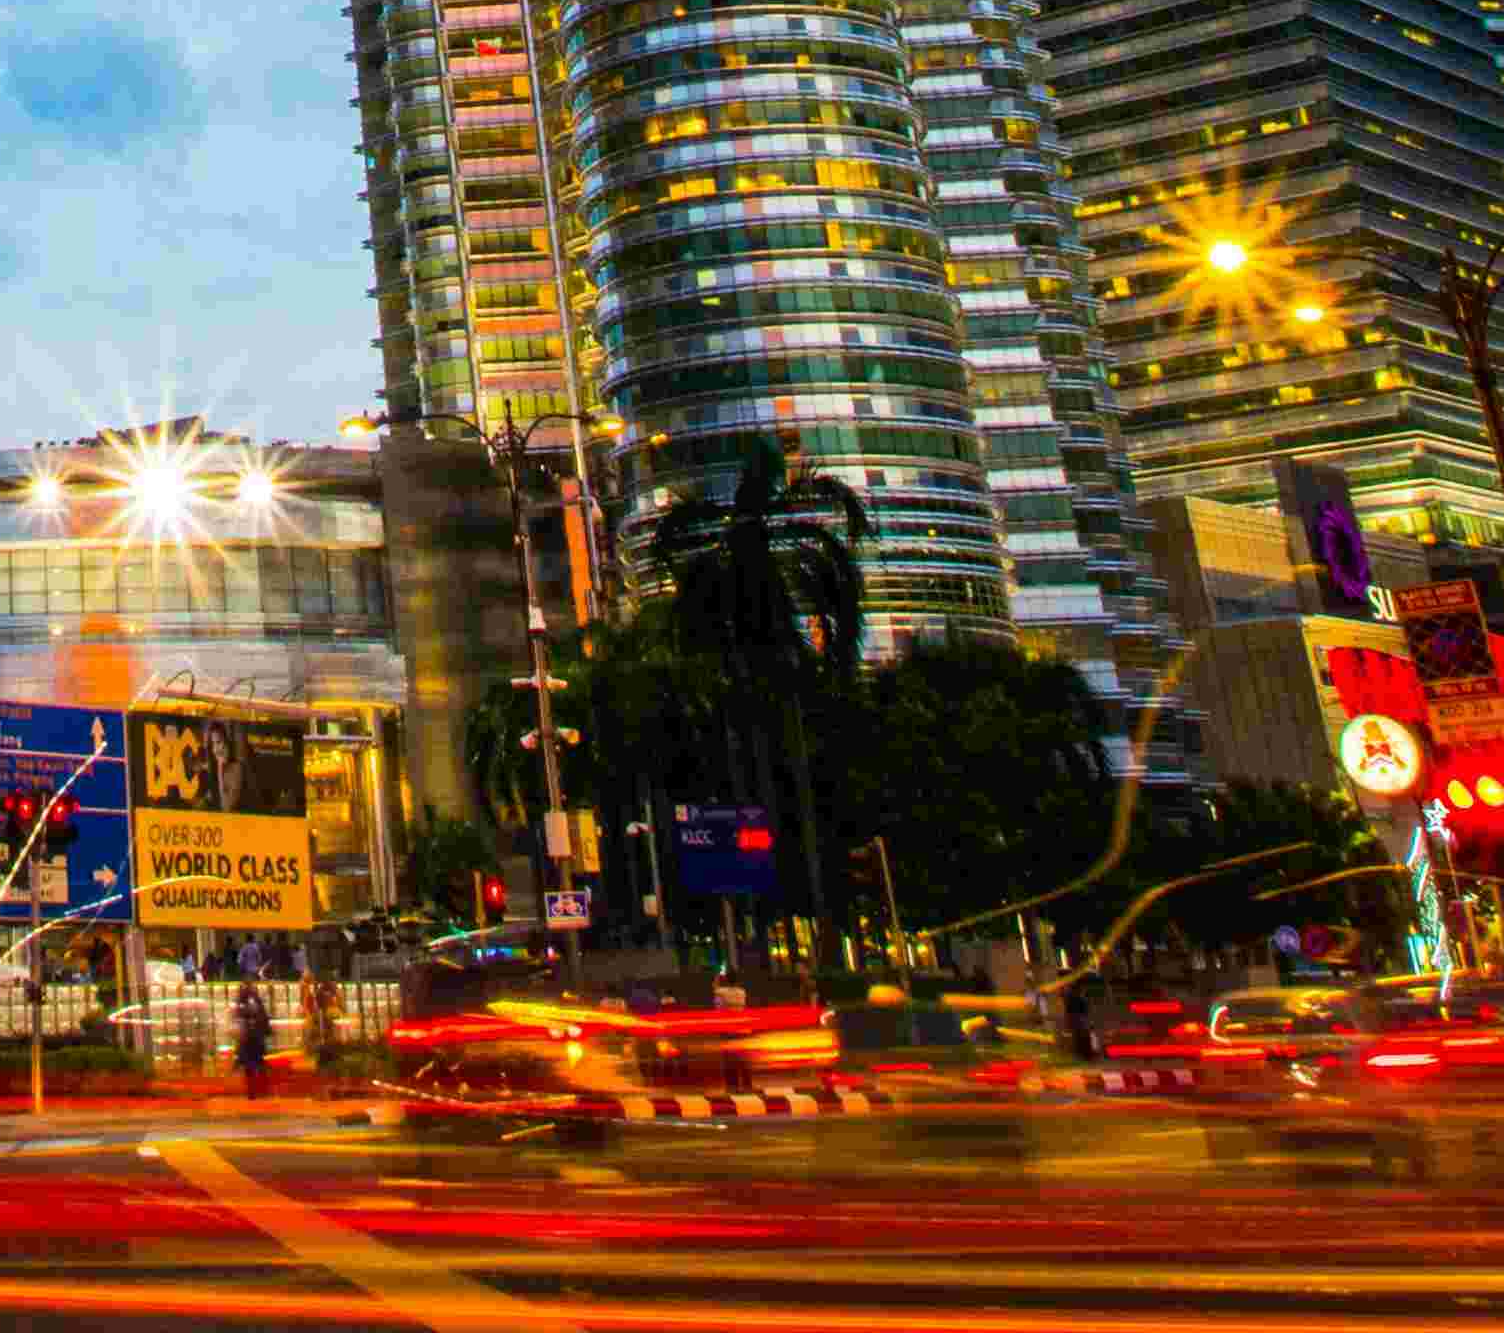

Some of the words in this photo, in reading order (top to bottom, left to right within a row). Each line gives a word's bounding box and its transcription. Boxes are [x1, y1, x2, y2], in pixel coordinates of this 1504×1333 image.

[148, 824, 189, 846] OVER
[192, 825, 223, 848] 300
[151, 851, 231, 880] WORLD
[239, 854, 300, 885] CLASS
[151, 886, 282, 913] QUALIFICATIONS
